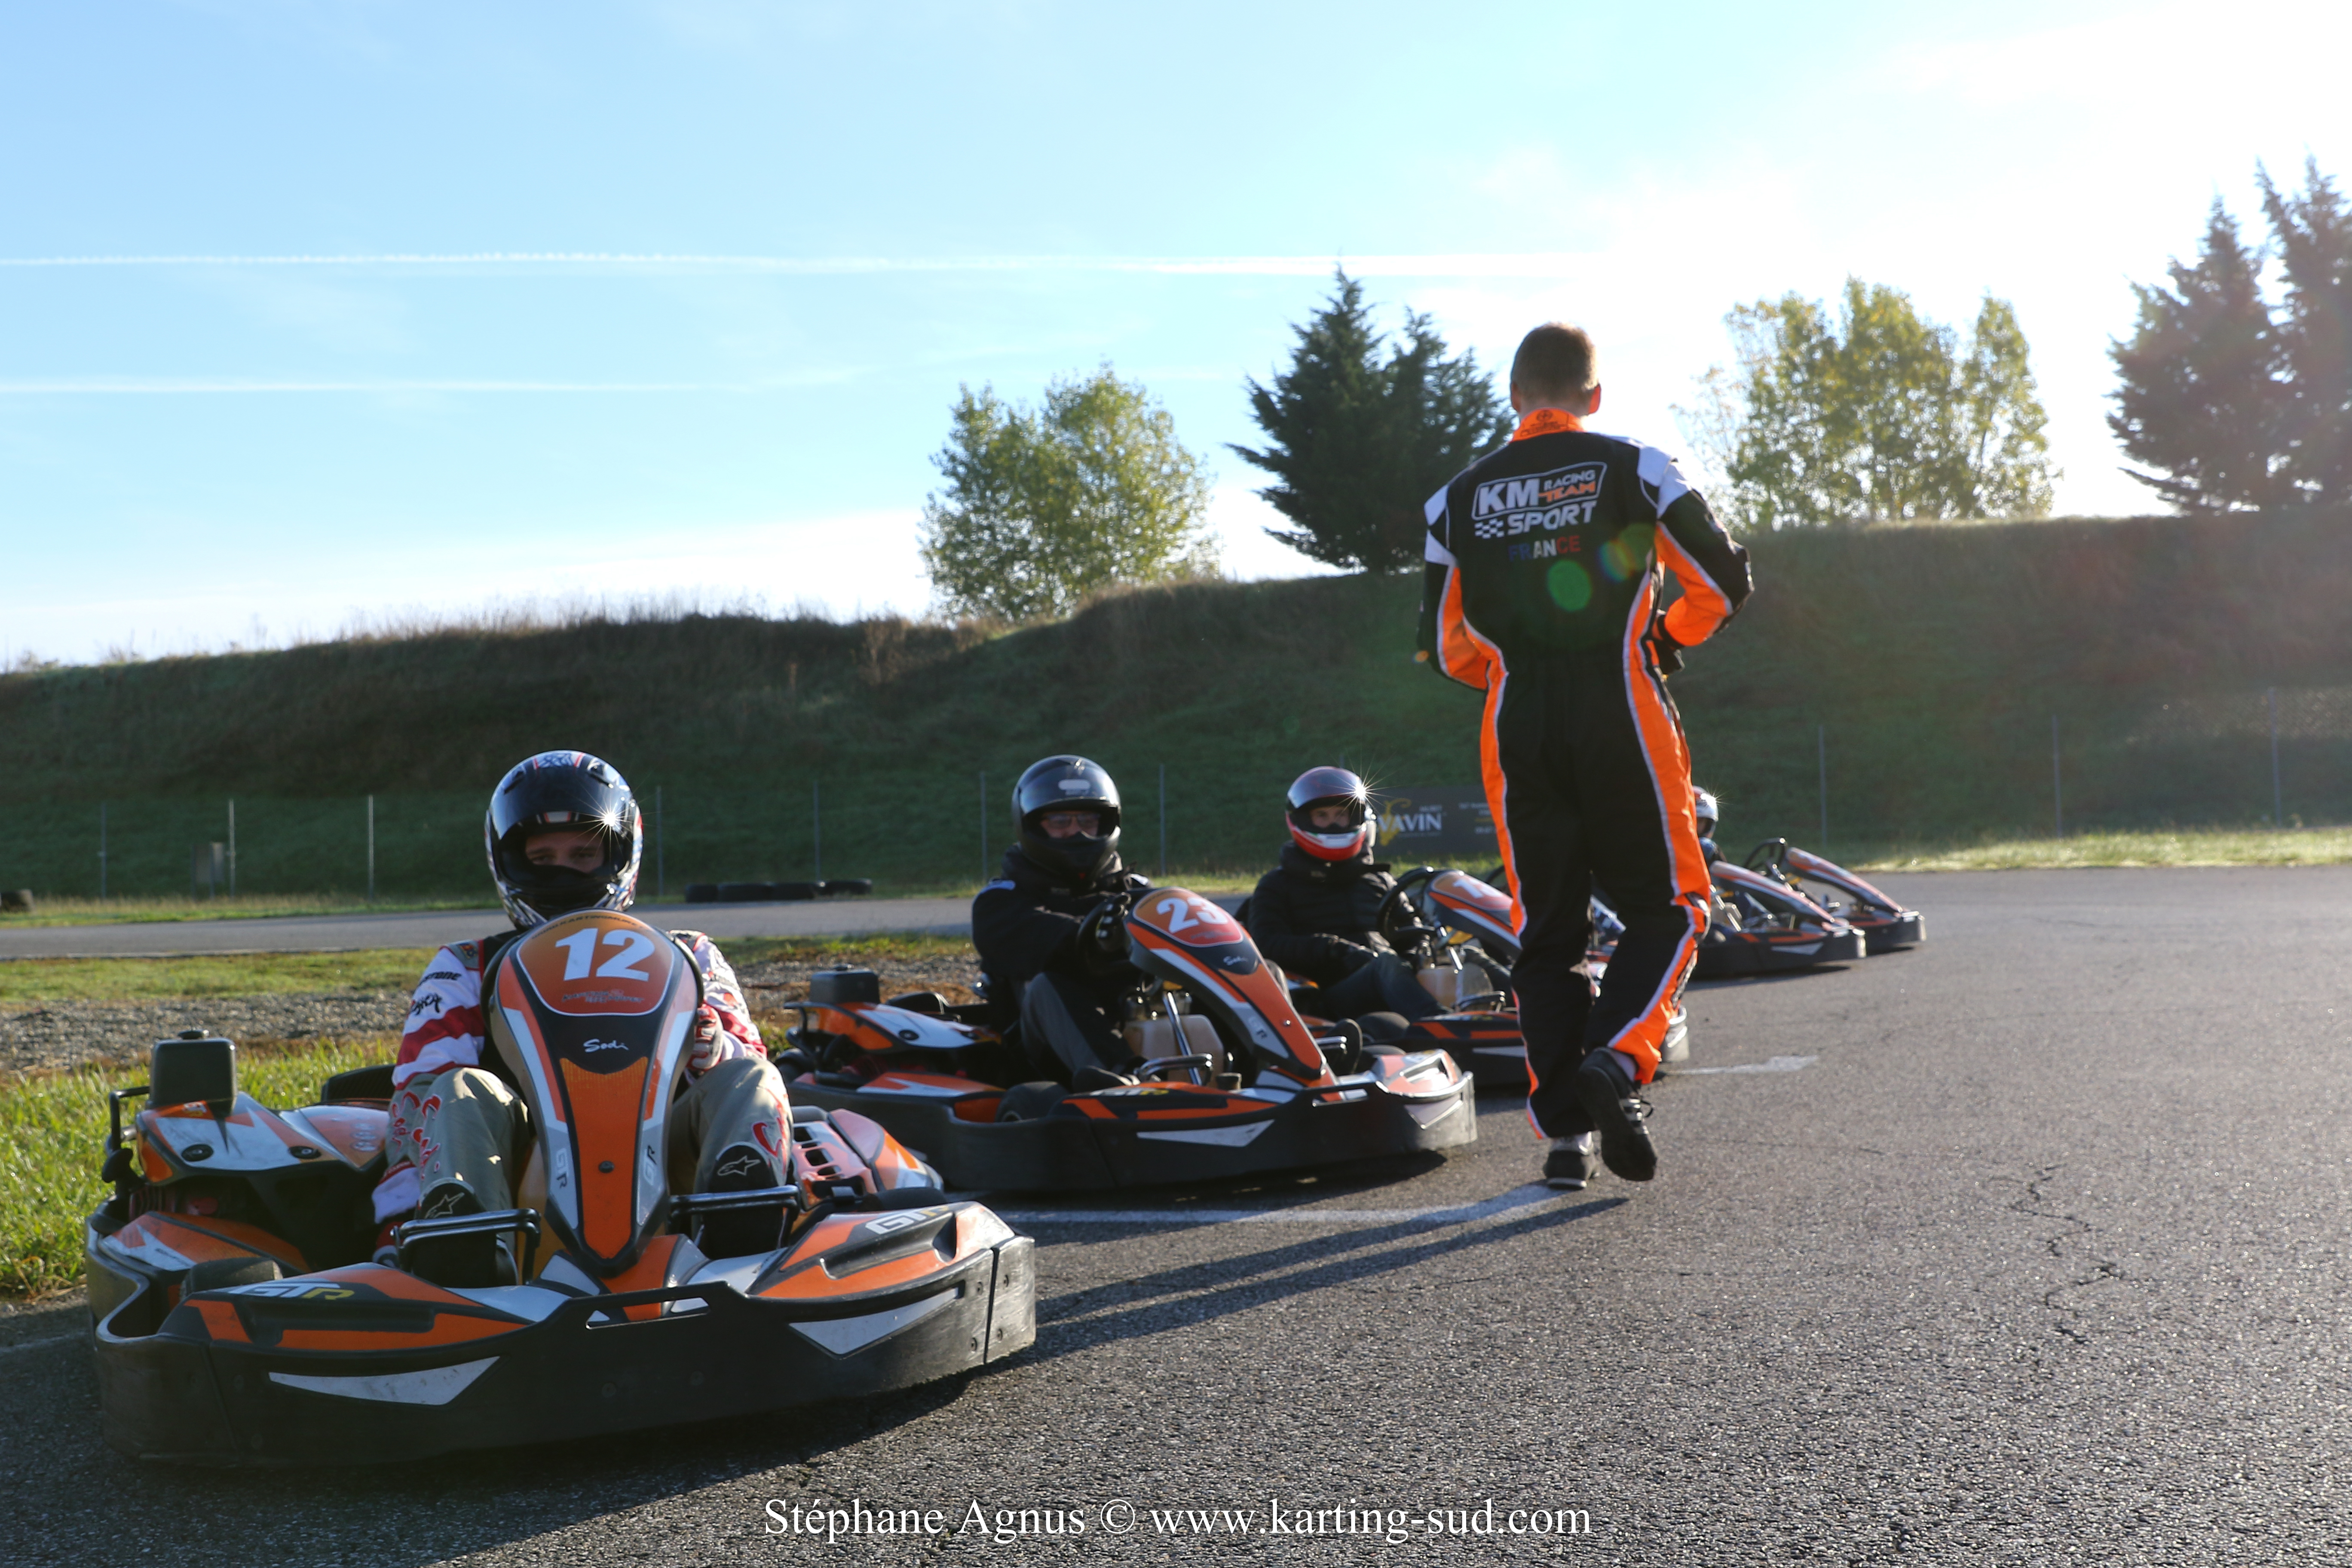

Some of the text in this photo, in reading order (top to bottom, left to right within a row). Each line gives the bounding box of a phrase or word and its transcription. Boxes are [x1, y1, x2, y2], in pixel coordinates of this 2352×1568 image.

[1538, 481, 1596, 502] TEAM
[1544, 469, 1596, 491] RACING
[1478, 478, 1540, 516] KM
[1507, 500, 1597, 536] SPORT
[1507, 535, 1581, 560] FRANCE
[1156, 897, 1228, 934] 23
[555, 928, 655, 982] 12
[583, 1038, 629, 1053] Sodi
